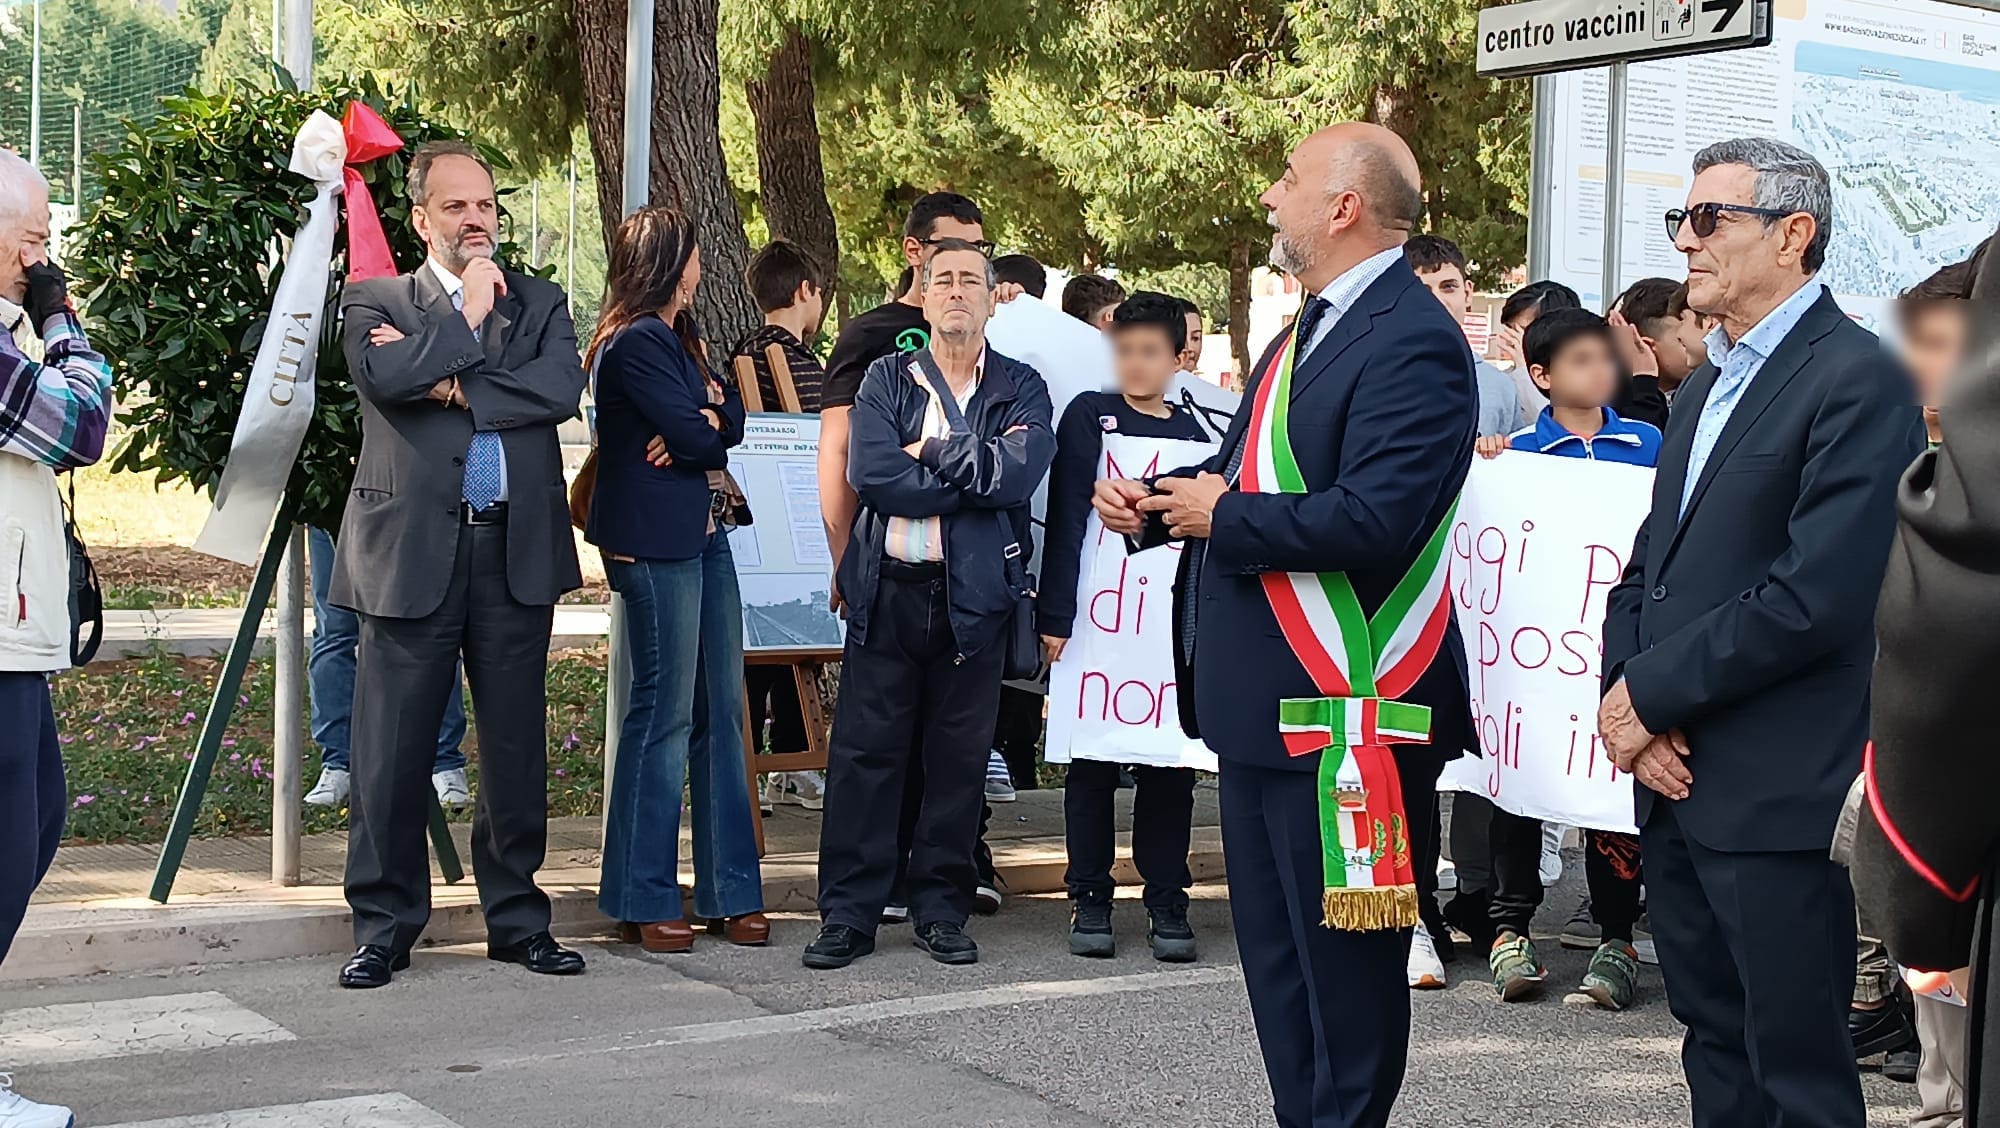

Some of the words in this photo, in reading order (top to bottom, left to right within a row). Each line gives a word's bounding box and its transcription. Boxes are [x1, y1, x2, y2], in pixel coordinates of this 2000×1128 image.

[1485, 19, 1554, 53] centro
[1565, 2, 1646, 42] vaccini
[1089, 556, 1149, 636] di
[1478, 621, 1603, 705] pos
